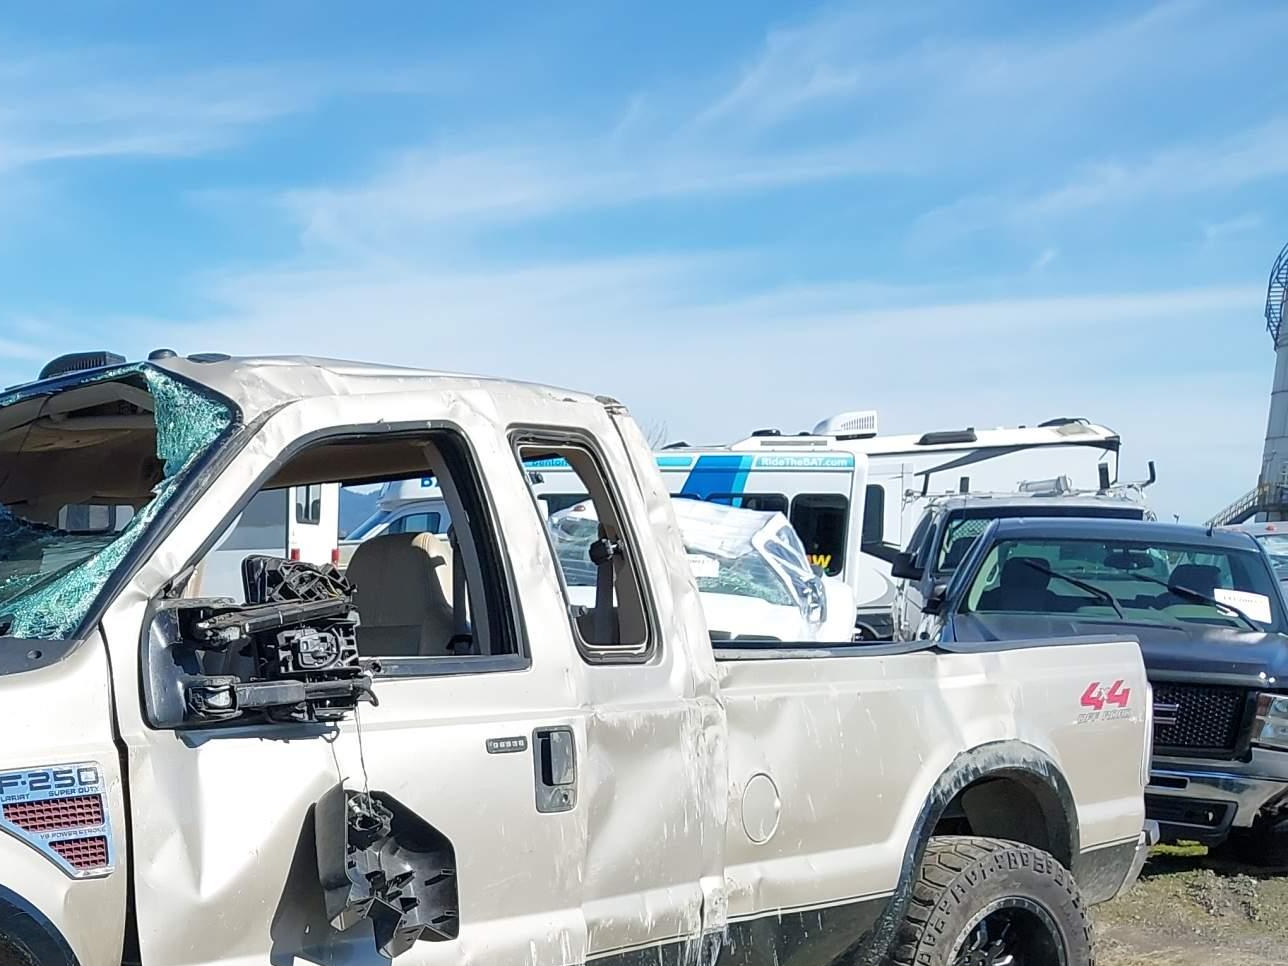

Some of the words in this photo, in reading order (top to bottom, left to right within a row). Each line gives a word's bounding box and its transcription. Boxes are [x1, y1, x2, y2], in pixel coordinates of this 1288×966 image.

[761, 456, 848, 466] RideTheBAT.com
[48, 789, 76, 798] SUPER
[78, 786, 101, 794] DUTY
[1, 793, 31, 802] LARIAT
[52, 829, 78, 838] POWER
